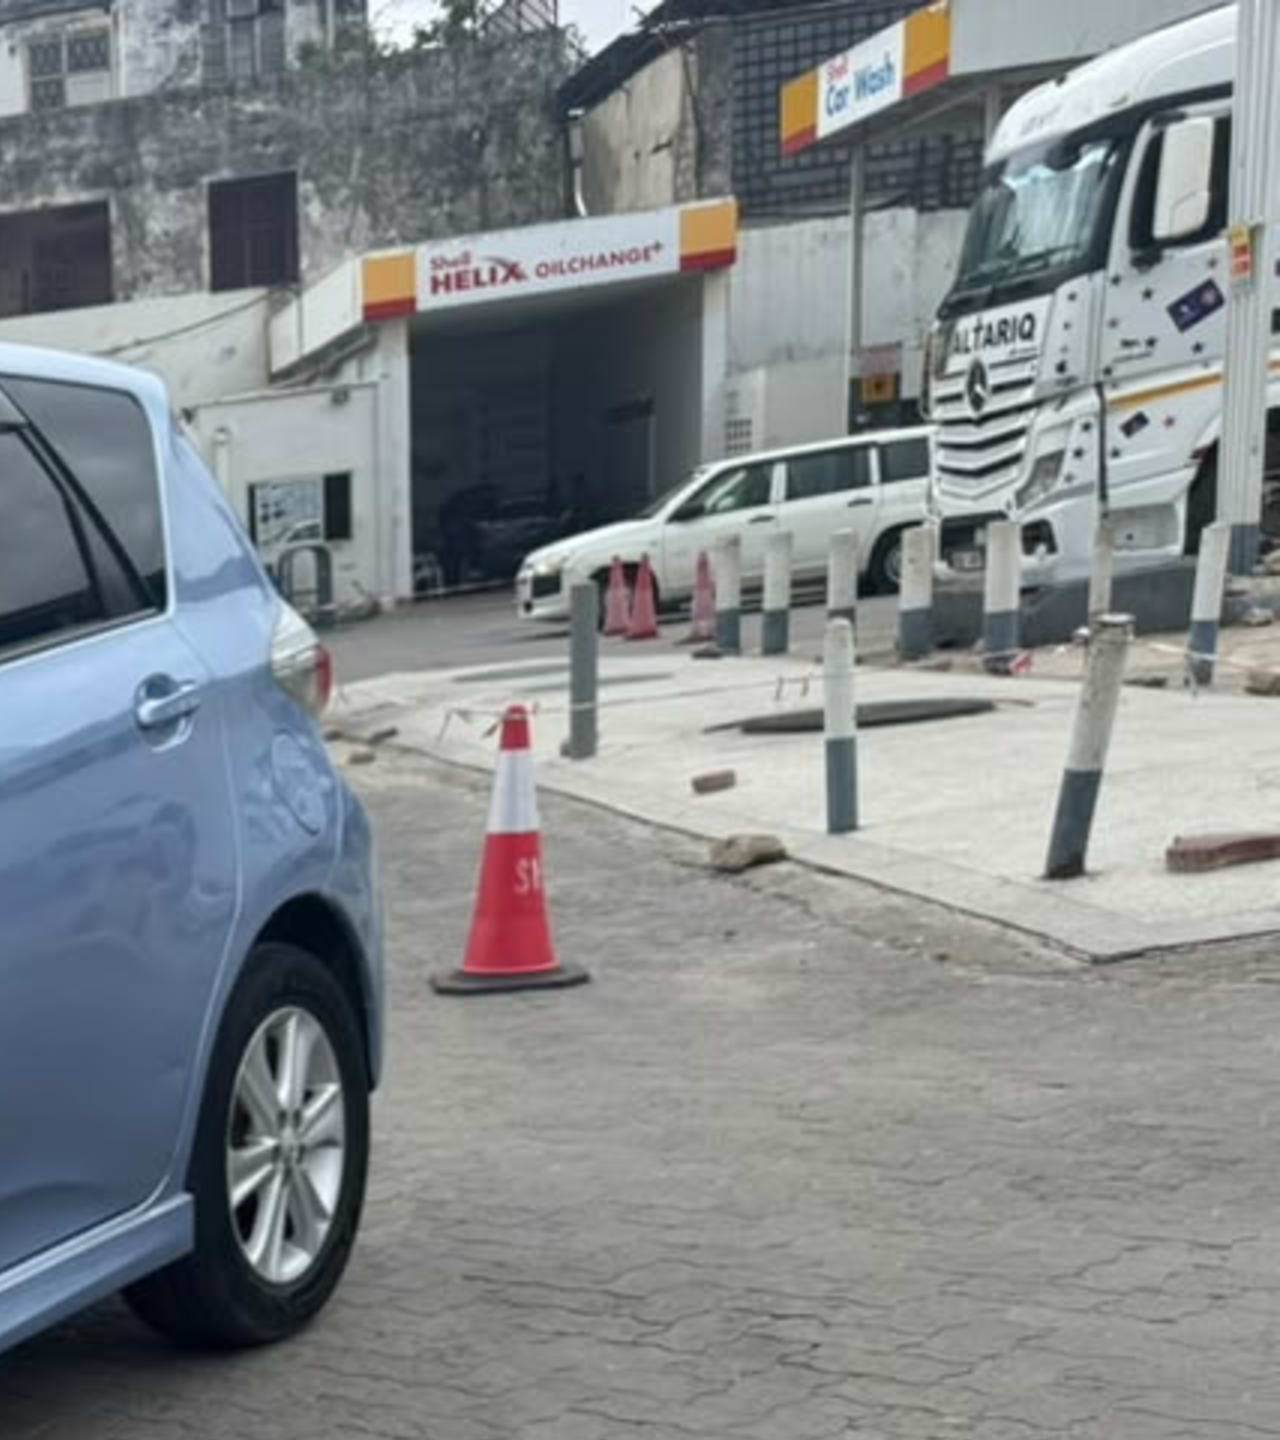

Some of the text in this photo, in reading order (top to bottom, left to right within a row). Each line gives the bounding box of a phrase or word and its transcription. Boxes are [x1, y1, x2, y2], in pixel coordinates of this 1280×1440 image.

[826, 52, 896, 118] Car Wash
[429, 251, 472, 272] Shell
[429, 258, 527, 295] HELIX
